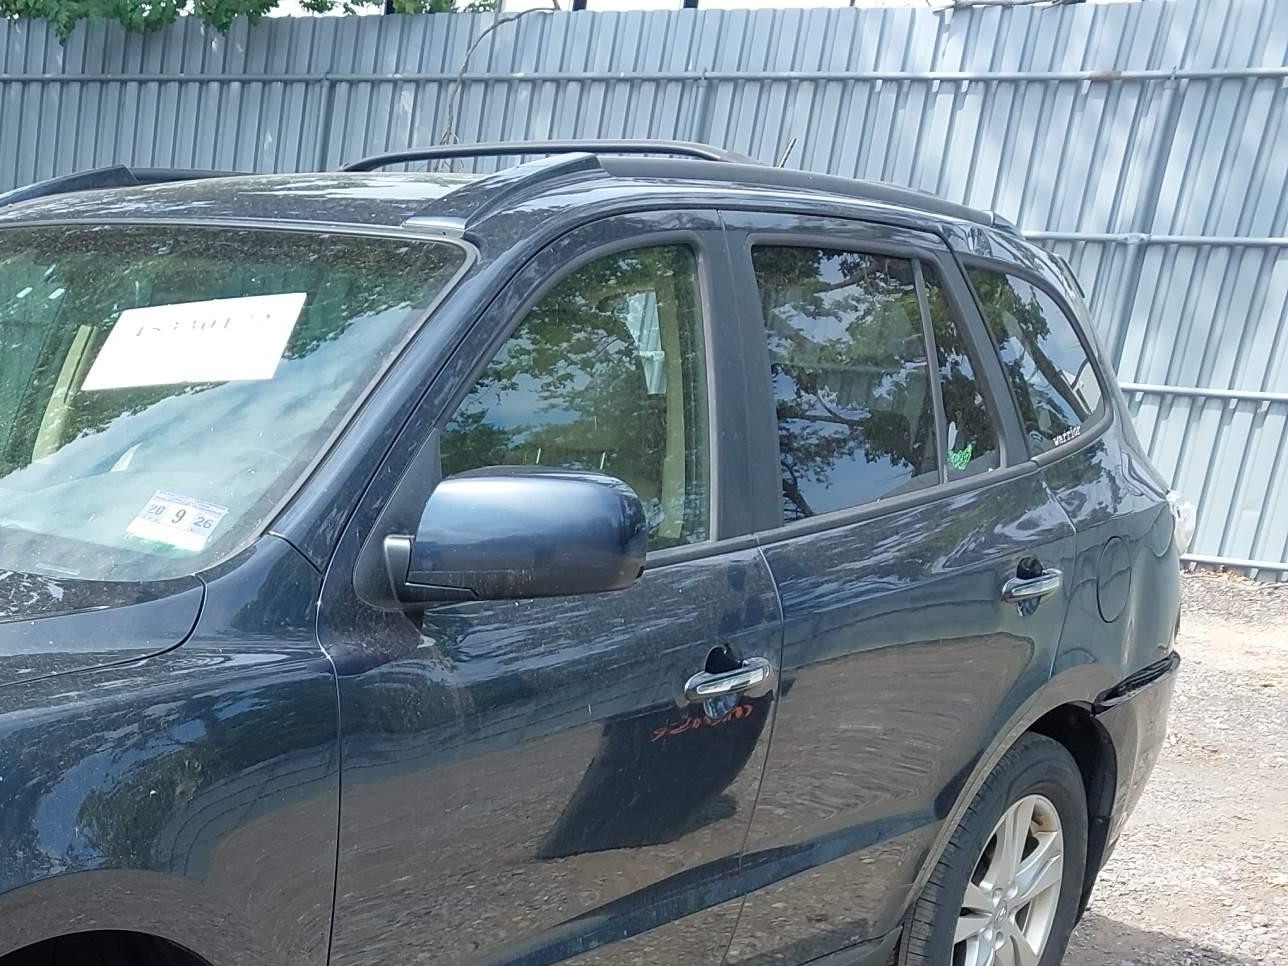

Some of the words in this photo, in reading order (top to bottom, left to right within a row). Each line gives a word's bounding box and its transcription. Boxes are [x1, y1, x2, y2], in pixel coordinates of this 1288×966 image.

[145, 503, 166, 516] 20
[171, 508, 187, 524] 9
[192, 516, 214, 529] 26
